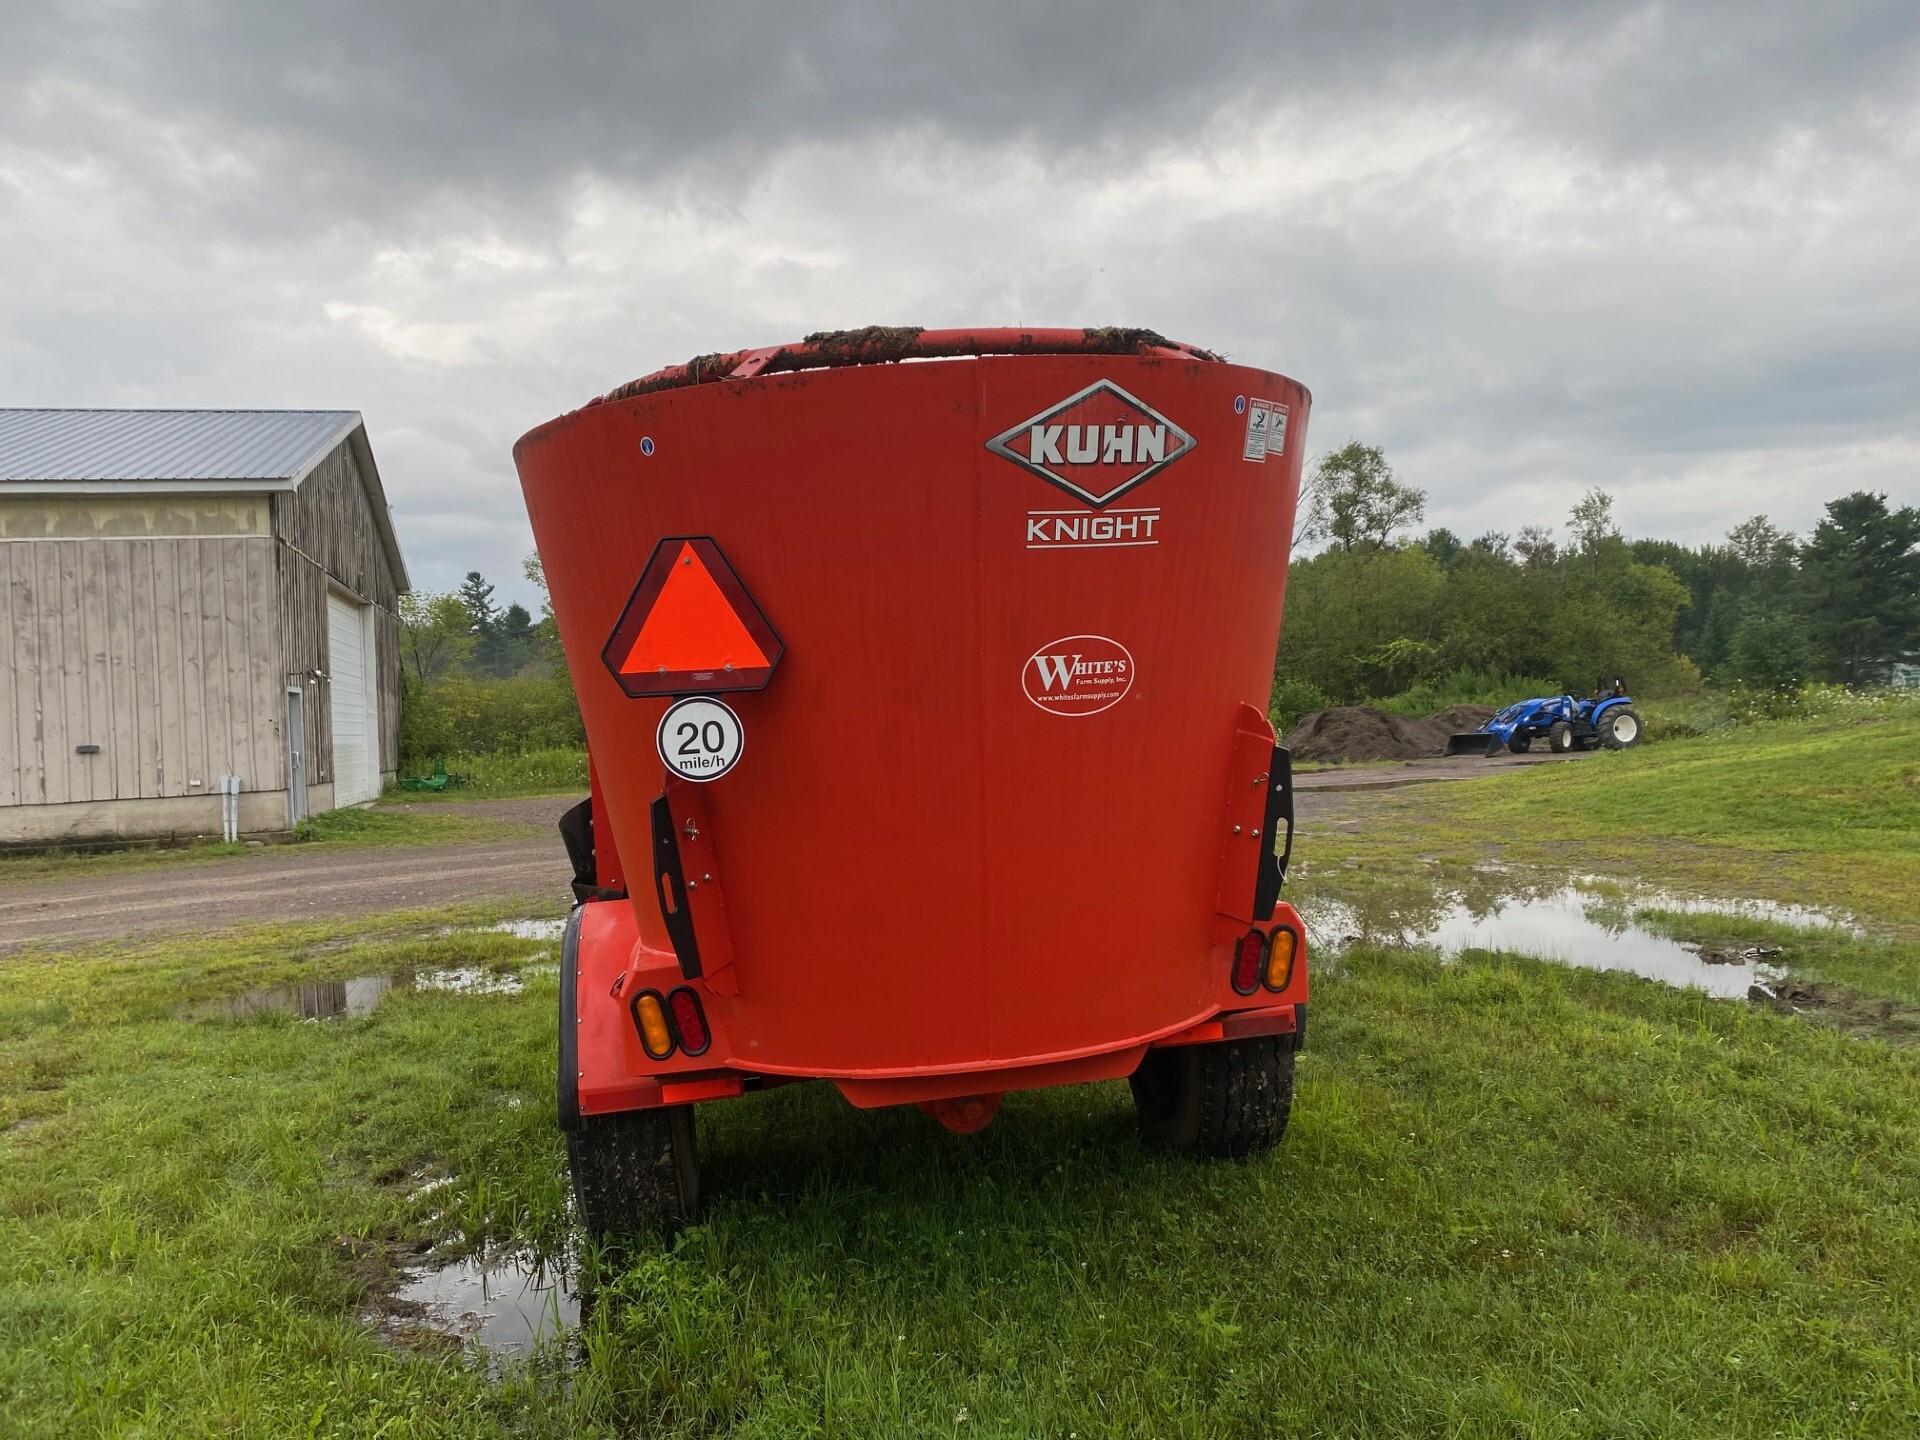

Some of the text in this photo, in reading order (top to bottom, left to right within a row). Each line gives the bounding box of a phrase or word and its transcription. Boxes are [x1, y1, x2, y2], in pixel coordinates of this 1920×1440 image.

[1030, 425, 1165, 463] KUHN
[1027, 515, 1160, 541] KNIGHT
[1037, 691, 1119, 702] www.whitesfarmsupply.com
[677, 720, 725, 755] 20
[680, 755, 725, 769] mile/h
